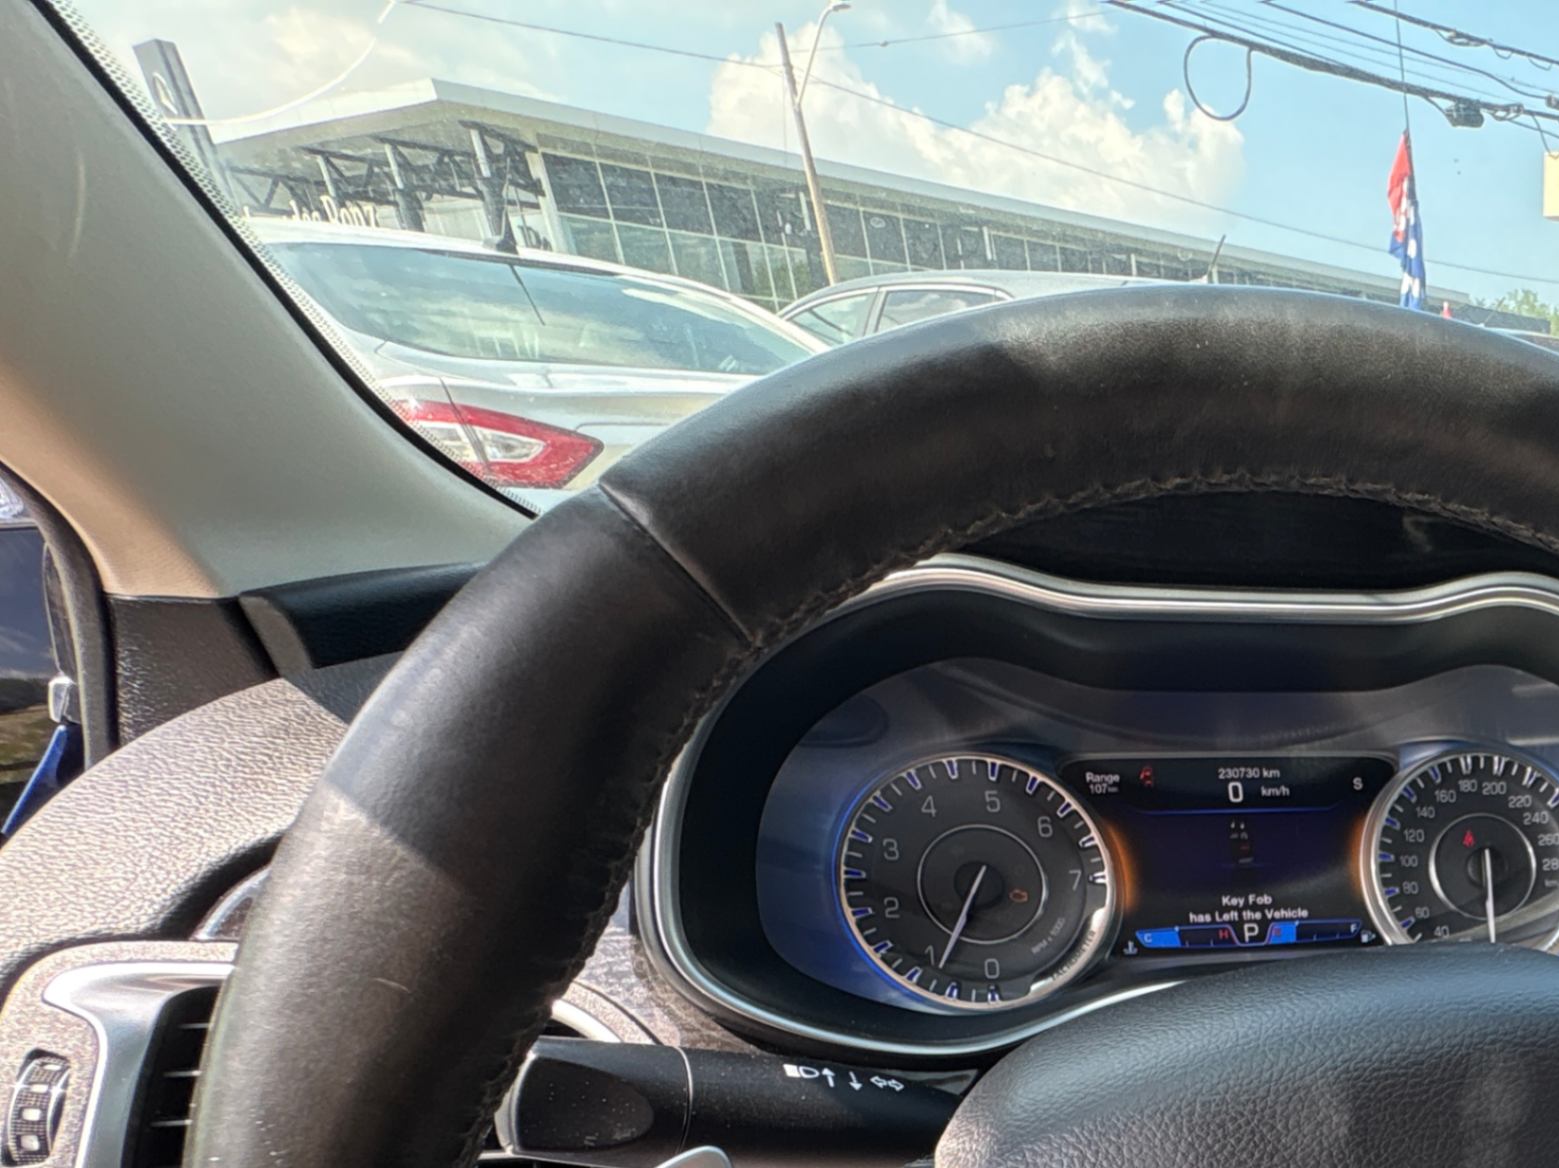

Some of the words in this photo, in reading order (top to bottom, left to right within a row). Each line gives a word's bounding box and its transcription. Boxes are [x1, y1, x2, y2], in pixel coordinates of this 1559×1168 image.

[1085, 771, 1120, 785] Range
[1218, 768, 1260, 780] 230730
[1263, 768, 1280, 779] km
[1227, 781, 1245, 804] 0
[1261, 786, 1290, 798] km/h
[1458, 779, 1478, 792] 180
[1482, 781, 1507, 795] 200
[985, 790, 1000, 812] 5
[1434, 789, 1456, 803] 160
[1508, 796, 1532, 808] 220
[921, 796, 937, 817] 4
[1416, 806, 1435, 818] 140
[1523, 811, 1549, 825] 240
[1037, 817, 1053, 837] 6
[1403, 829, 1424, 842] 120
[883, 838, 900, 860] 3
[1400, 855, 1419, 867] 100
[1068, 869, 1082, 891] 7
[1402, 881, 1418, 894] 80
[883, 897, 900, 918] 2
[1222, 896, 1245, 908] Key
[1249, 894, 1272, 905] Fob
[1190, 912, 1211, 923] has
[1215, 911, 1239, 922] Left
[1242, 909, 1262, 920] the
[1265, 908, 1308, 919] Vehicle
[1243, 924, 1259, 943] P
[1434, 926, 1449, 937] 40
[924, 945, 936, 967] 1
[984, 958, 1000, 979] 0
